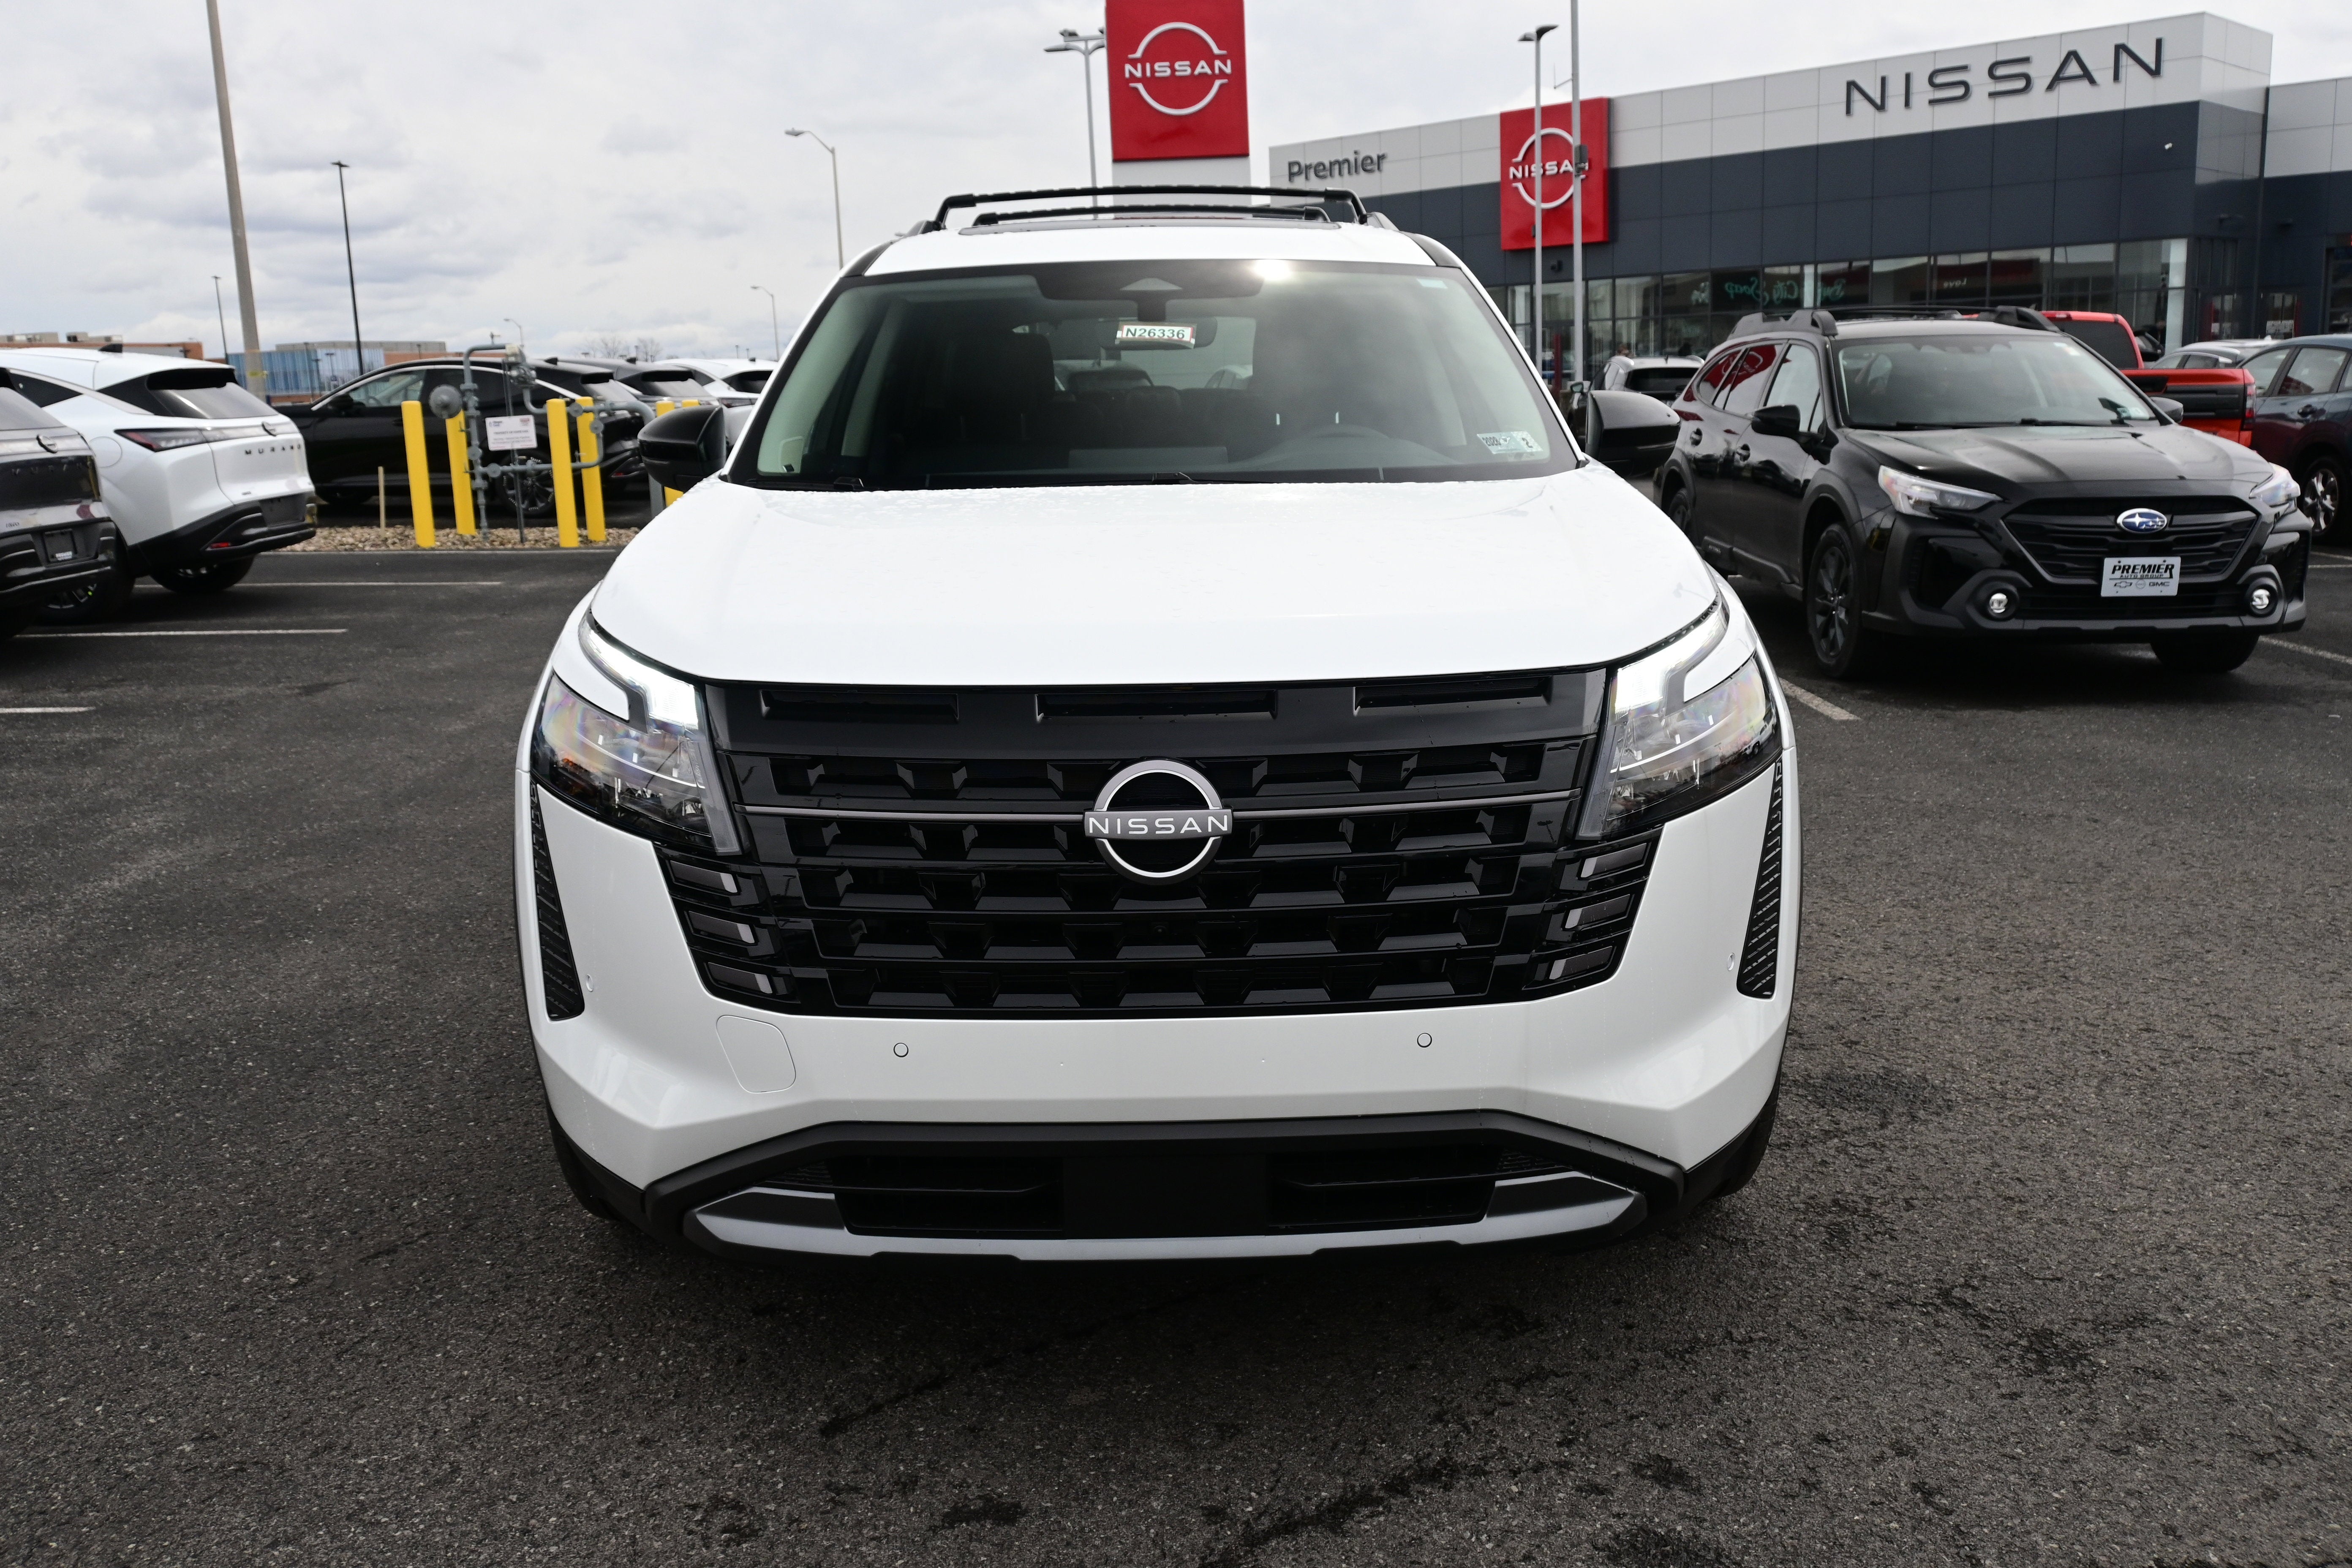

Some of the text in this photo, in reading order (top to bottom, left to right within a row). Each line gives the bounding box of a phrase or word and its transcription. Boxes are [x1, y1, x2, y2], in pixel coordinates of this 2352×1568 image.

[1124, 59, 1232, 79] NISSAN
[1846, 37, 2164, 116] NISSAN
[1288, 150, 1387, 182] Premier
[1509, 159, 1588, 180] NISSA
[1125, 328, 1185, 339] N26336
[2112, 564, 2175, 578] PREMIER
[1089, 815, 1228, 834] NISSAN
